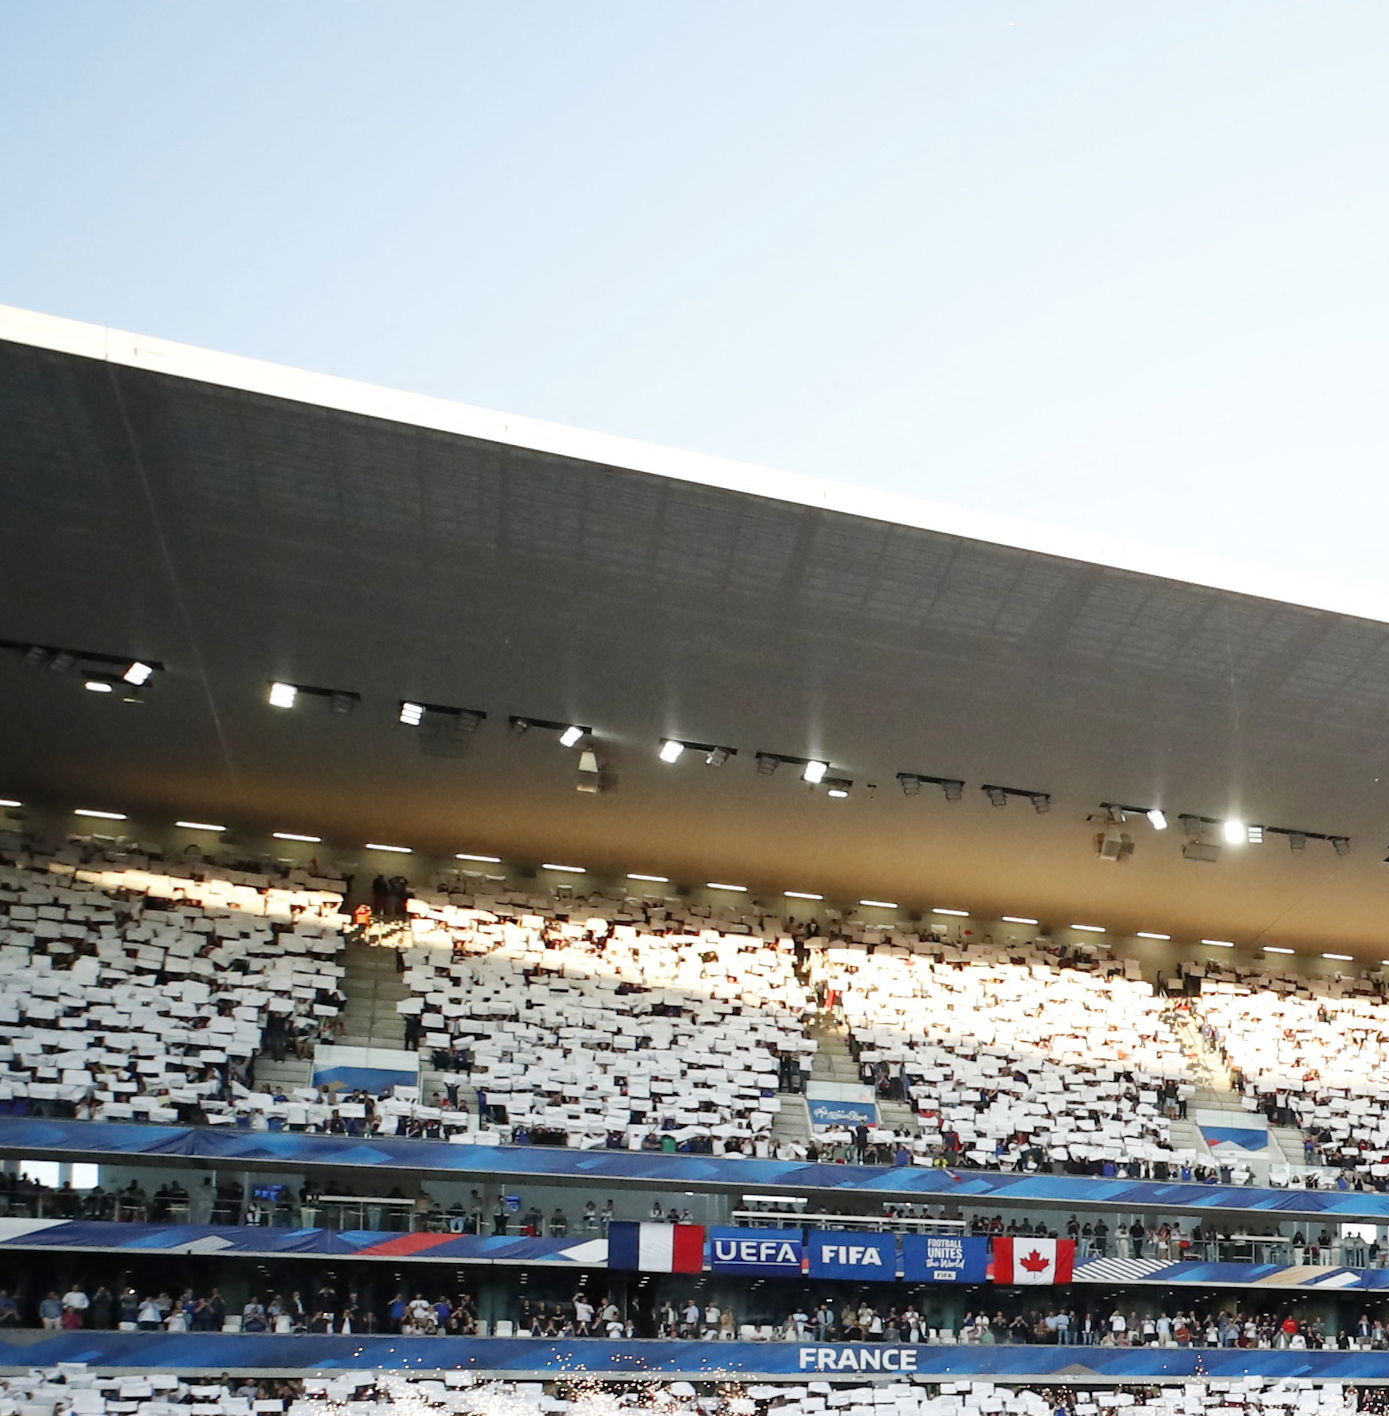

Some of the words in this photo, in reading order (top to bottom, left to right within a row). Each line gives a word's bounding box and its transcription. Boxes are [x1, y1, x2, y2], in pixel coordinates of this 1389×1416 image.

[715, 1240, 798, 1263] UEFA
[927, 1238, 962, 1248] FOOTBALL
[927, 1247, 963, 1259] UNITES
[821, 1245, 882, 1266] FIFA
[799, 1347, 918, 1371] FRANCE
